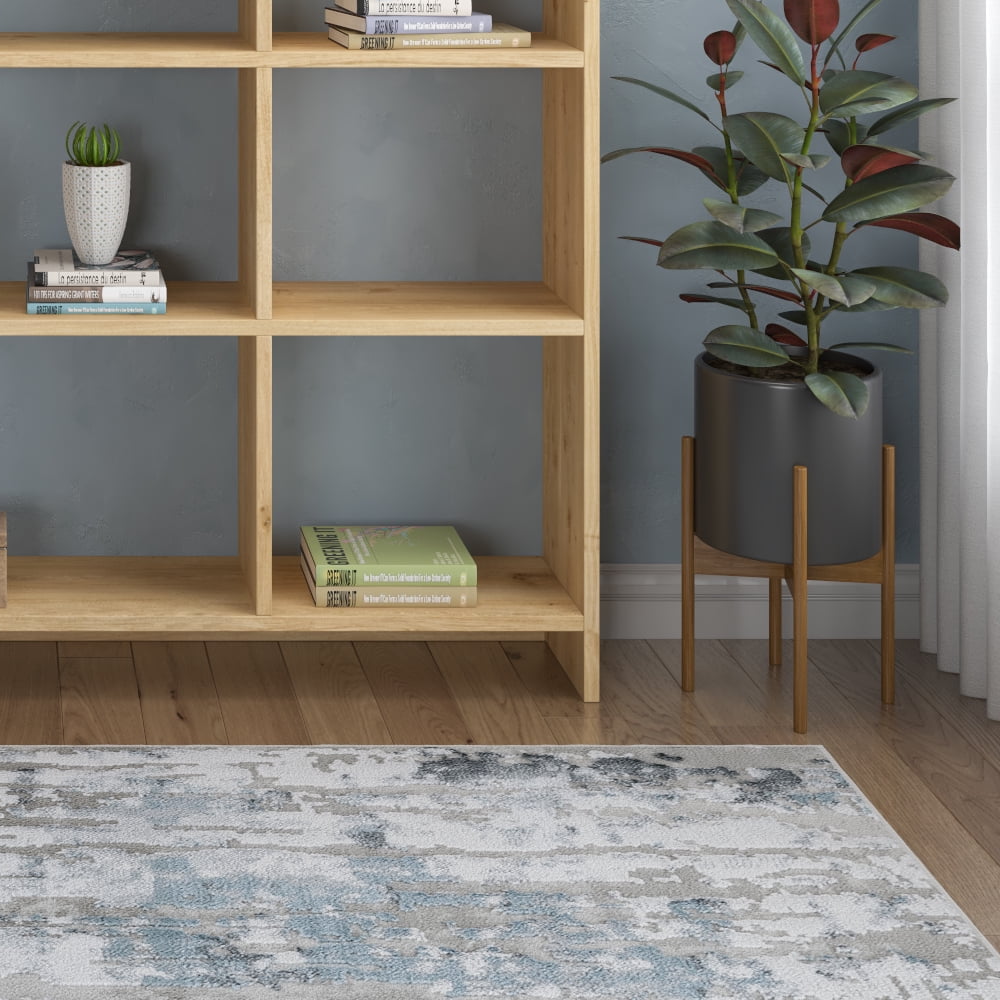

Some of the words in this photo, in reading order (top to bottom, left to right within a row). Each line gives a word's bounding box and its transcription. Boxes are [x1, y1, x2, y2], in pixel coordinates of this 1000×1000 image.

[386, 0, 415, 15] persistance
[418, 0, 424, 12] du
[426, 0, 441, 12] destin
[374, 20, 393, 34] GREENING
[360, 38, 388, 49] GREENING
[389, 37, 396, 49] IT
[66, 273, 99, 285] persistance
[101, 273, 108, 284] du
[110, 272, 126, 284] destin
[36, 306, 58, 314] GREENING
[317, 533, 349, 565] GREENING
[326, 570, 351, 586] GREENING
[351, 570, 357, 586] IT
[326, 591, 351, 607] GREENING
[351, 591, 357, 606] IT
